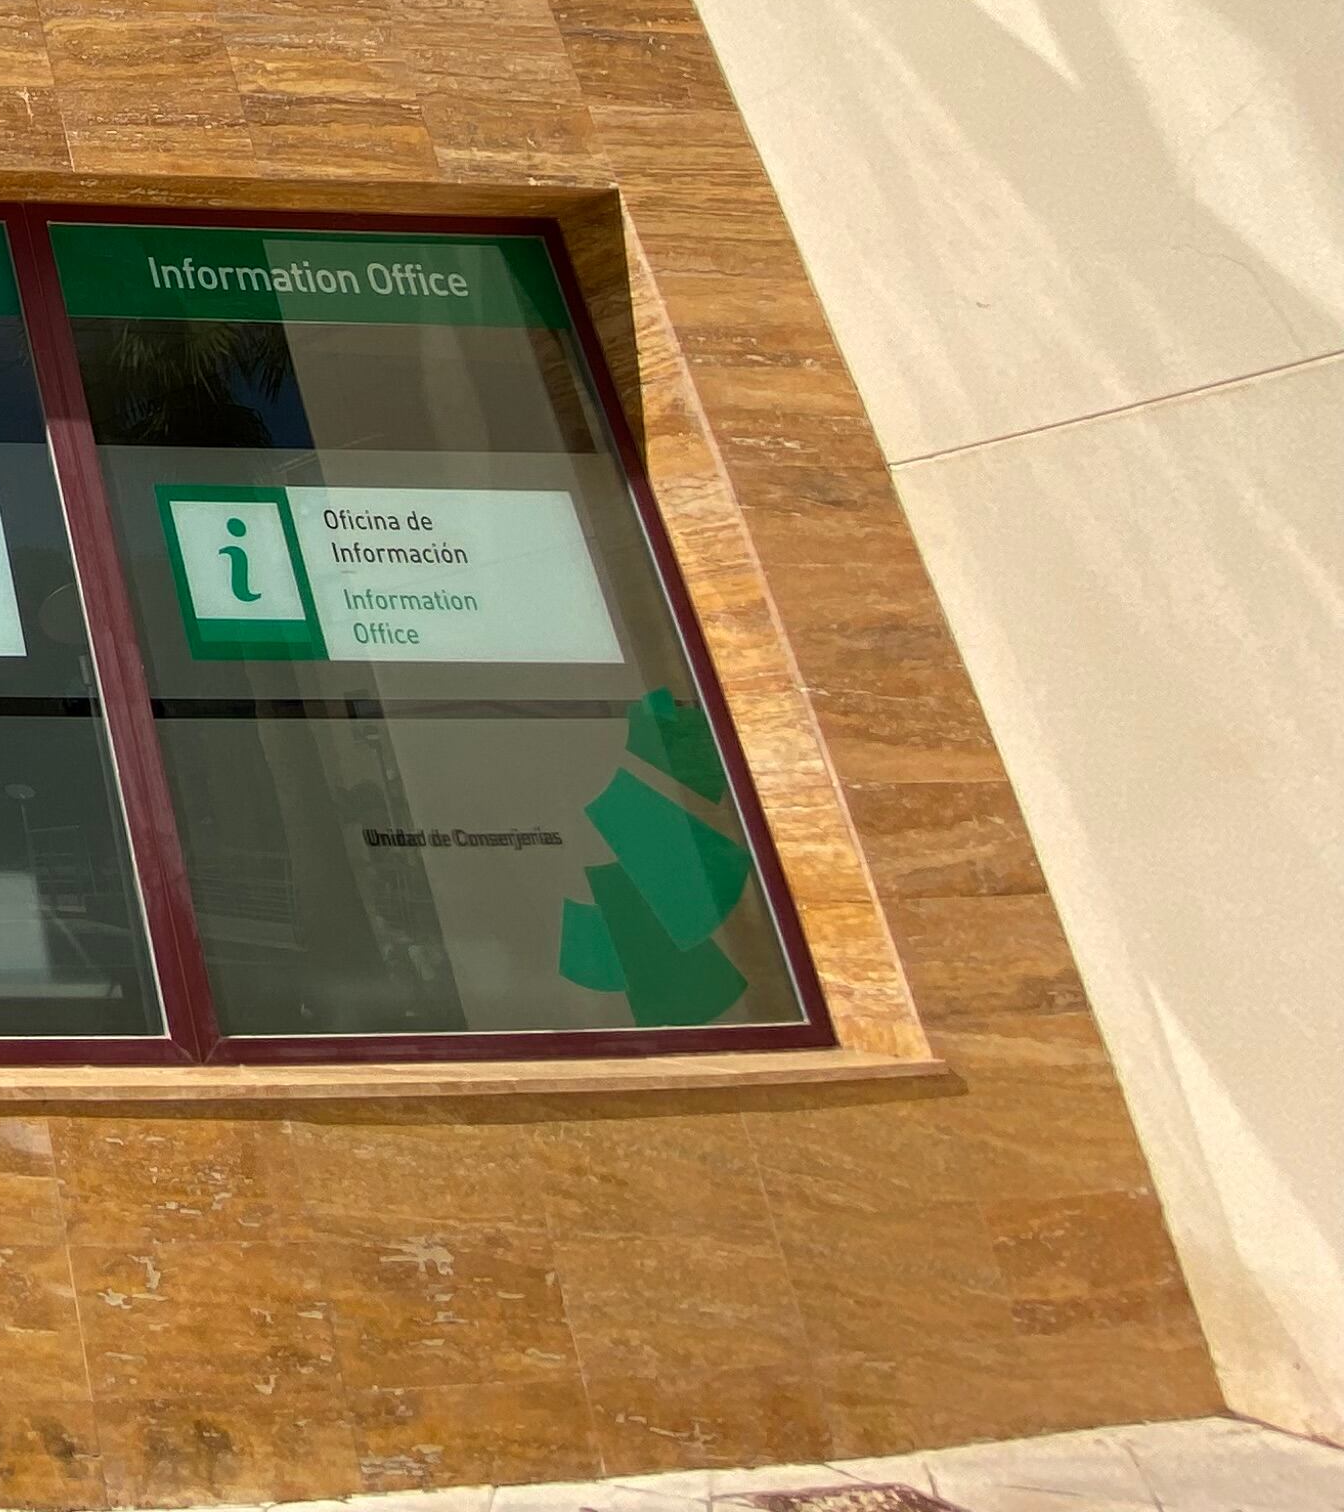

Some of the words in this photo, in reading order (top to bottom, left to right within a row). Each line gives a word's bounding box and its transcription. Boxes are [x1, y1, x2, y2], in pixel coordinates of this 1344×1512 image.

[148, 256, 361, 295] Information
[366, 262, 469, 297] Office
[323, 509, 400, 530] Oficina
[407, 511, 433, 531] de
[331, 542, 468, 564] Información
[343, 588, 478, 611] Information
[353, 622, 420, 645] Office
